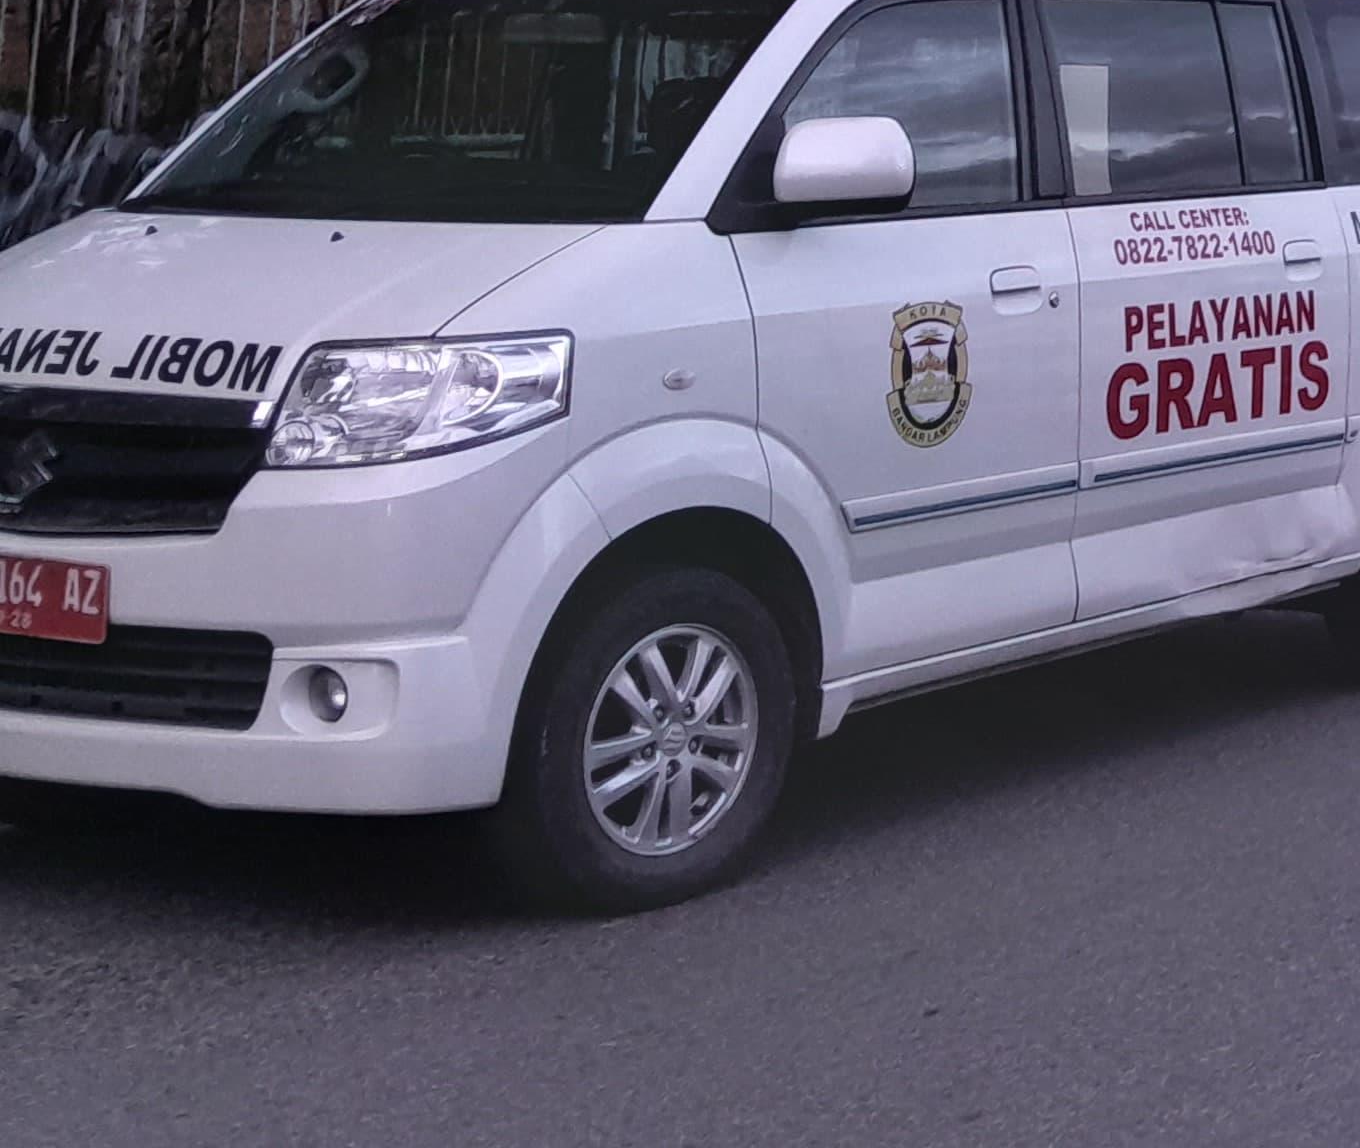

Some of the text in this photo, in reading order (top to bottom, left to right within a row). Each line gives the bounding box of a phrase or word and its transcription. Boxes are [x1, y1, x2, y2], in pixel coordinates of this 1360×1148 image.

[1129, 206, 1250, 233] CALL CENTER:
[1113, 229, 1276, 266] 0822-7822-1400
[909, 306, 947, 320] KOTA
[1124, 289, 1316, 353] PELAYANAN
[1106, 339, 1330, 441] GRATIS
[62, 567, 101, 616] AZ
